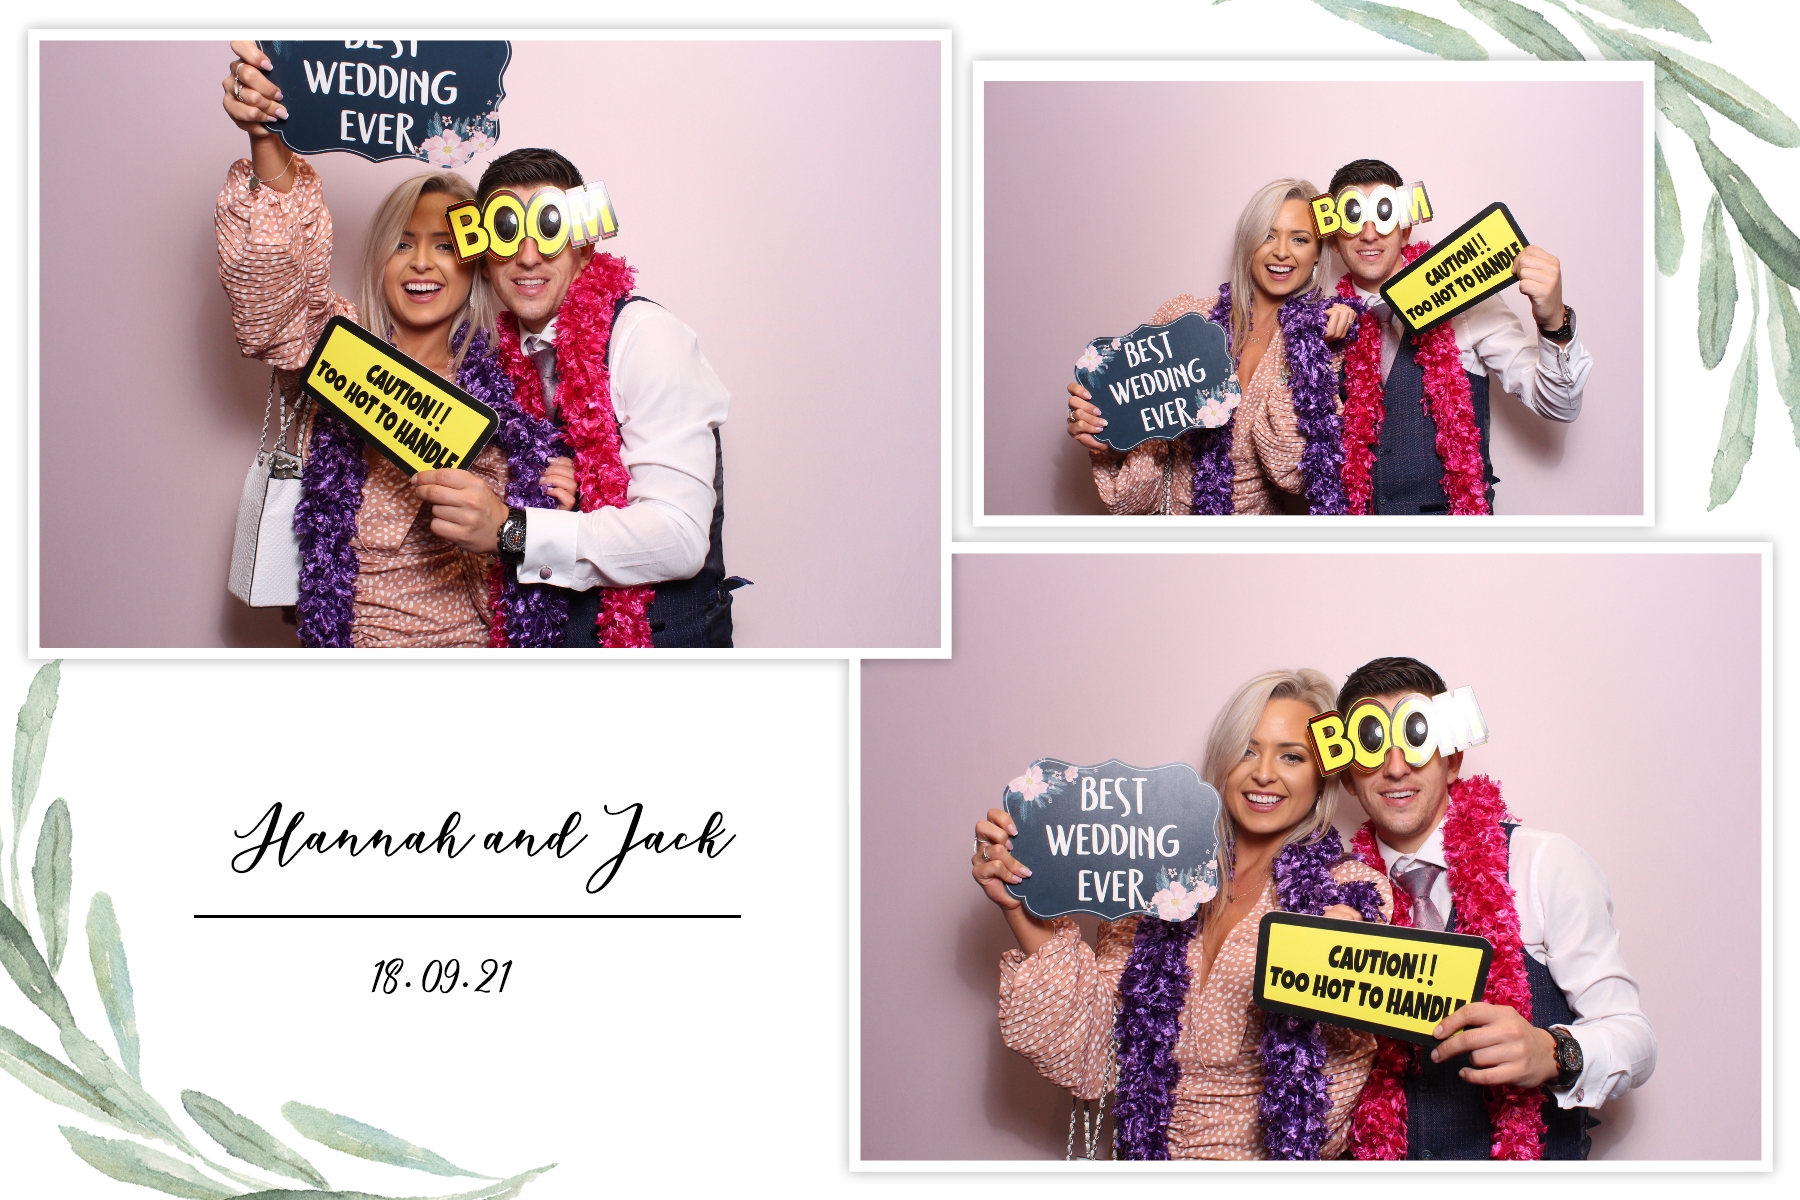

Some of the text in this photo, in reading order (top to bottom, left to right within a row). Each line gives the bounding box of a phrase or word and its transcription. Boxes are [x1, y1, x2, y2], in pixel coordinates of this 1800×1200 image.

[303, 59, 458, 106] WEDDING
[340, 110, 416, 154] EVER
[445, 180, 619, 264] BOOM
[1309, 181, 1434, 239] BOOM
[1425, 232, 1491, 286] CAUTION!!
[1405, 303, 1433, 321] TOO
[1430, 282, 1458, 308] HOT
[1454, 274, 1476, 293] TO
[1124, 331, 1173, 368] BEST
[316, 359, 347, 391] TOO
[343, 381, 380, 415] HOT
[374, 403, 398, 431] TO
[366, 364, 452, 432] CAUTION!!
[1108, 358, 1206, 405] WEDDING
[1140, 397, 1195, 432] EVER
[1307, 685, 1489, 777] BOOM
[1081, 776, 1148, 816] BEST
[1045, 823, 1180, 860] WEDDING
[1078, 868, 1147, 909] EVER
[1270, 966, 1310, 989] TOO
[1312, 974, 1355, 1000] HOT
[1358, 982, 1384, 1009] TO
[1328, 944, 1438, 986] CAUTION!!
